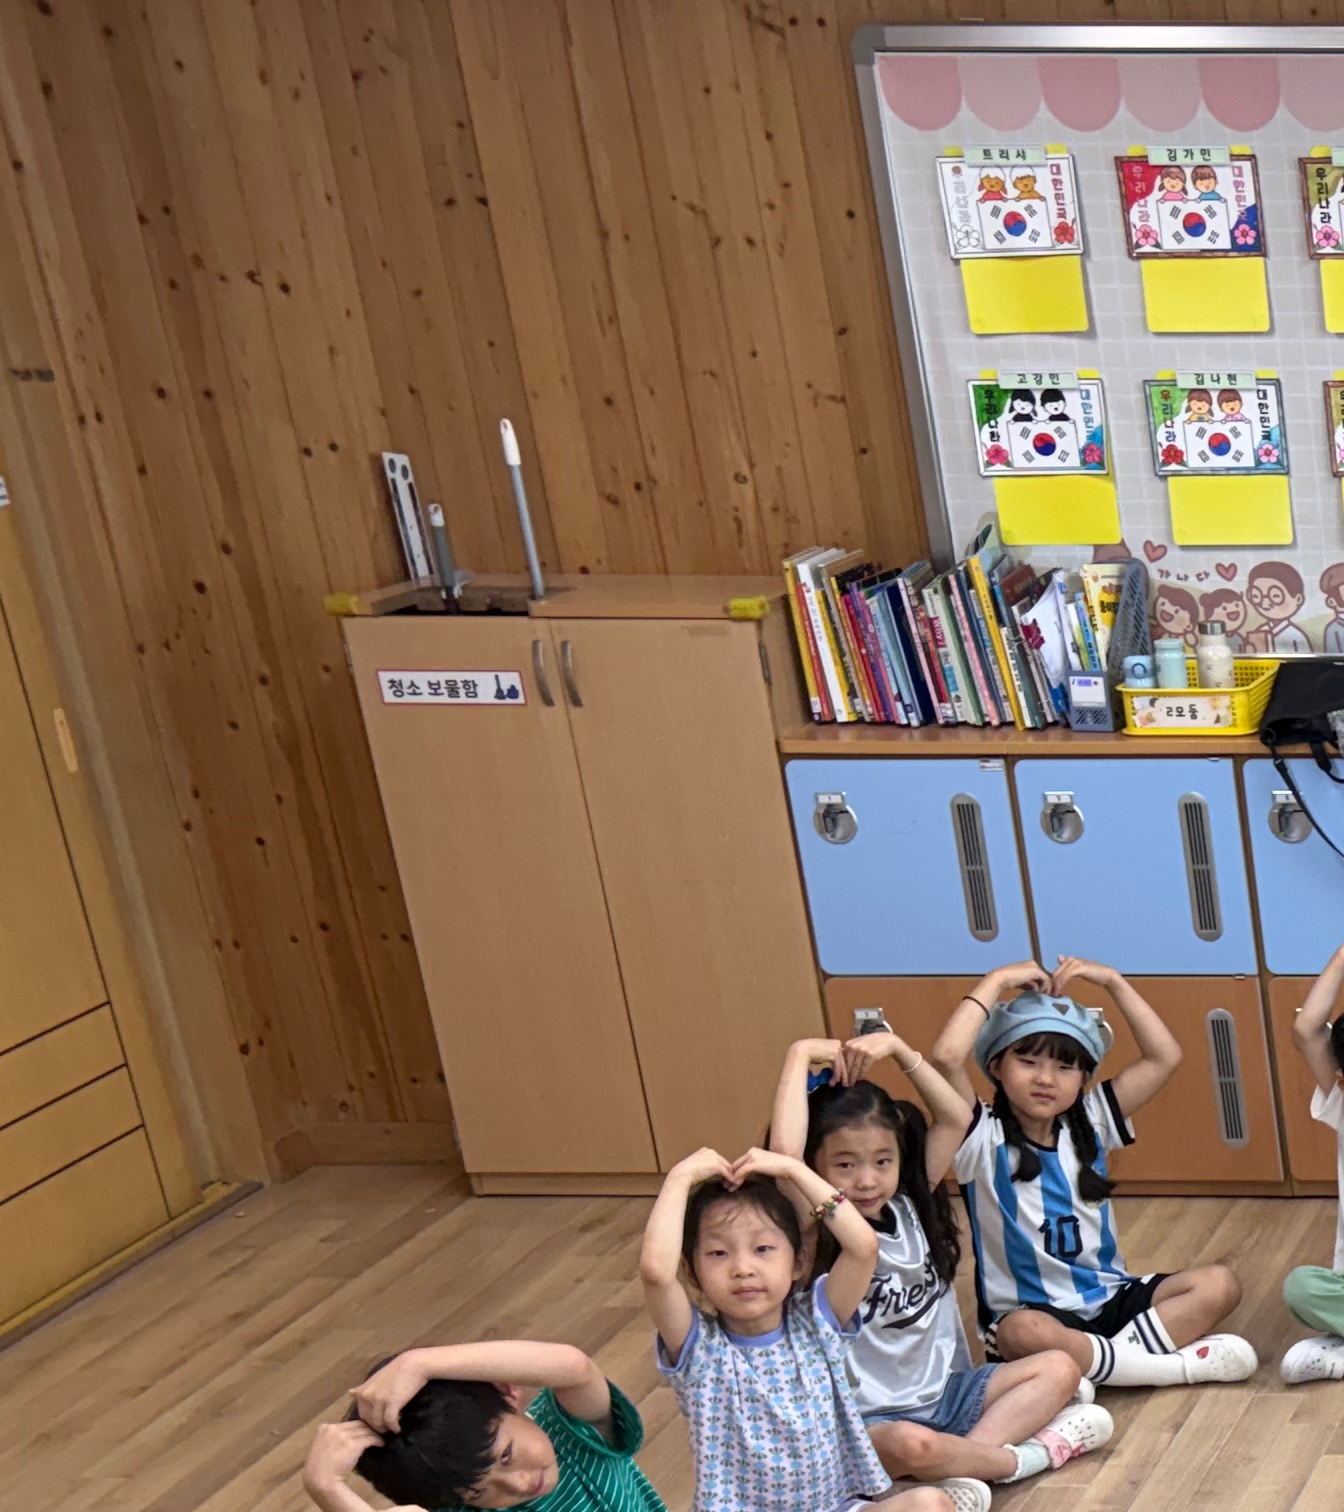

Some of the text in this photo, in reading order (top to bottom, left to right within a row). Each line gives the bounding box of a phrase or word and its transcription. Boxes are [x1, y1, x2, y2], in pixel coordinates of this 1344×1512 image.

[1166, 149, 1209, 161] 김가민
[1315, 167, 1332, 224] 우리나라
[1194, 373, 1237, 385] 김나현
[1160, 389, 1176, 443] 우리나라
[1255, 389, 1272, 442] 대한민국
[387, 678, 478, 699] 청소 보물함
[1038, 1215, 1083, 1258] 10
